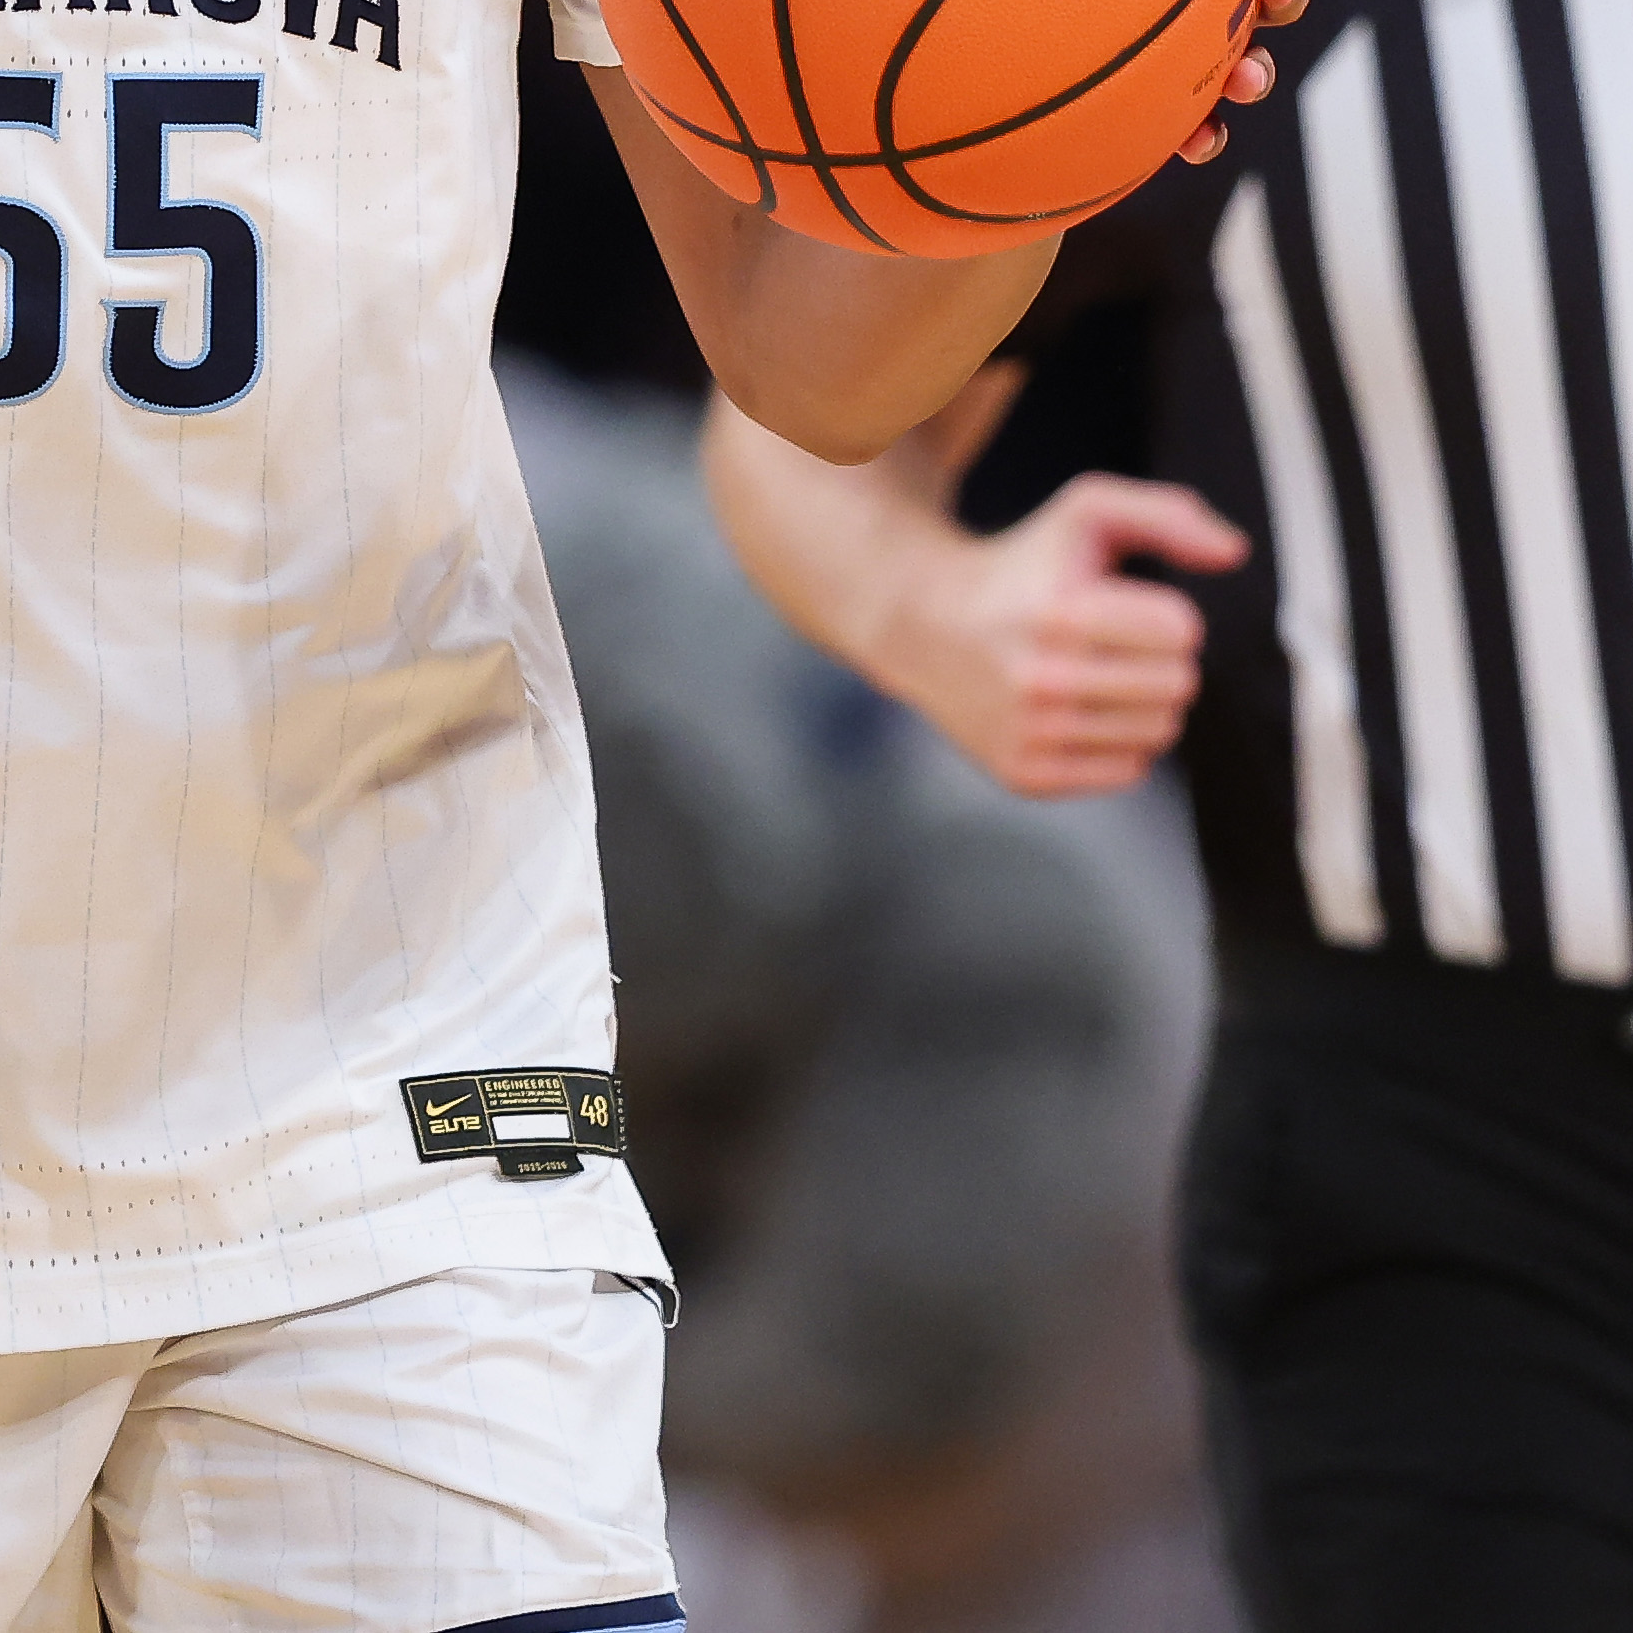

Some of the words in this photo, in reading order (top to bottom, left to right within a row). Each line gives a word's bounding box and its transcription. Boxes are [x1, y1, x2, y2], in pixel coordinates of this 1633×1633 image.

[484, 1078, 561, 1092] ENGINEERED
[579, 1094, 609, 1127] 48
[428, 1115, 482, 1134] ELITE
